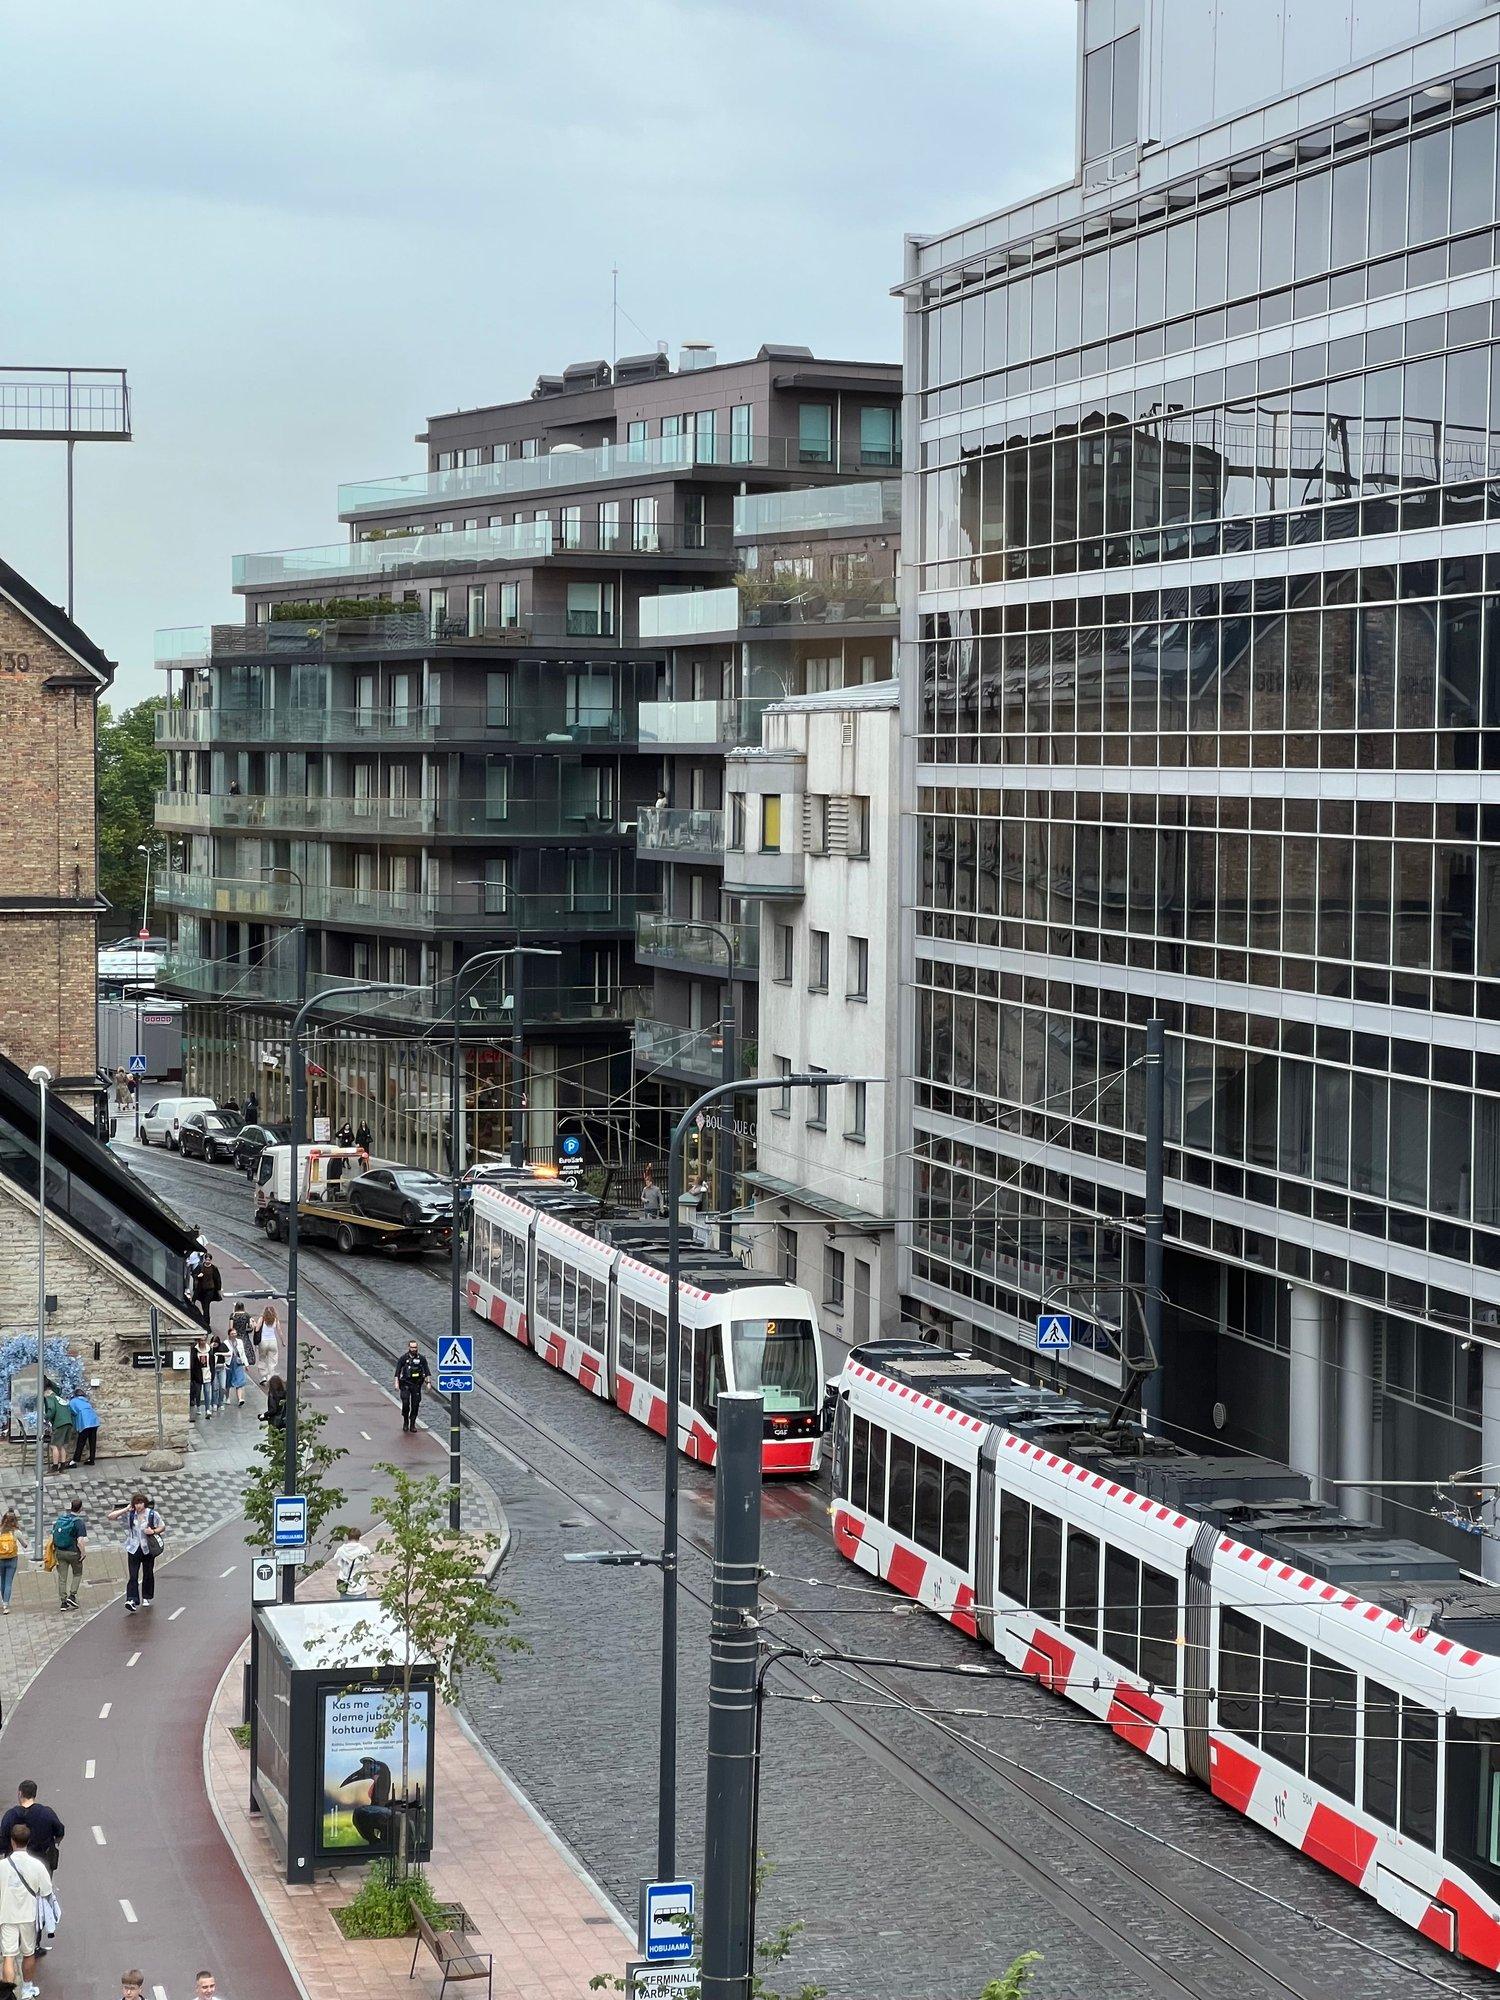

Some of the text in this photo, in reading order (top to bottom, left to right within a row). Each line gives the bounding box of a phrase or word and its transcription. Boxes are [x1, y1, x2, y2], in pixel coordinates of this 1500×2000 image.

[0, 652, 29, 672] 30
[706, 1115, 748, 1135] BOUUE
[767, 1322, 776, 1334] 2
[178, 1356, 185, 1365] 2
[332, 1701, 351, 1710] Kas
[353, 1701, 370, 1709] me
[332, 1713, 364, 1723] oleme
[649, 1943, 690, 1953] HOBUJAAMA
